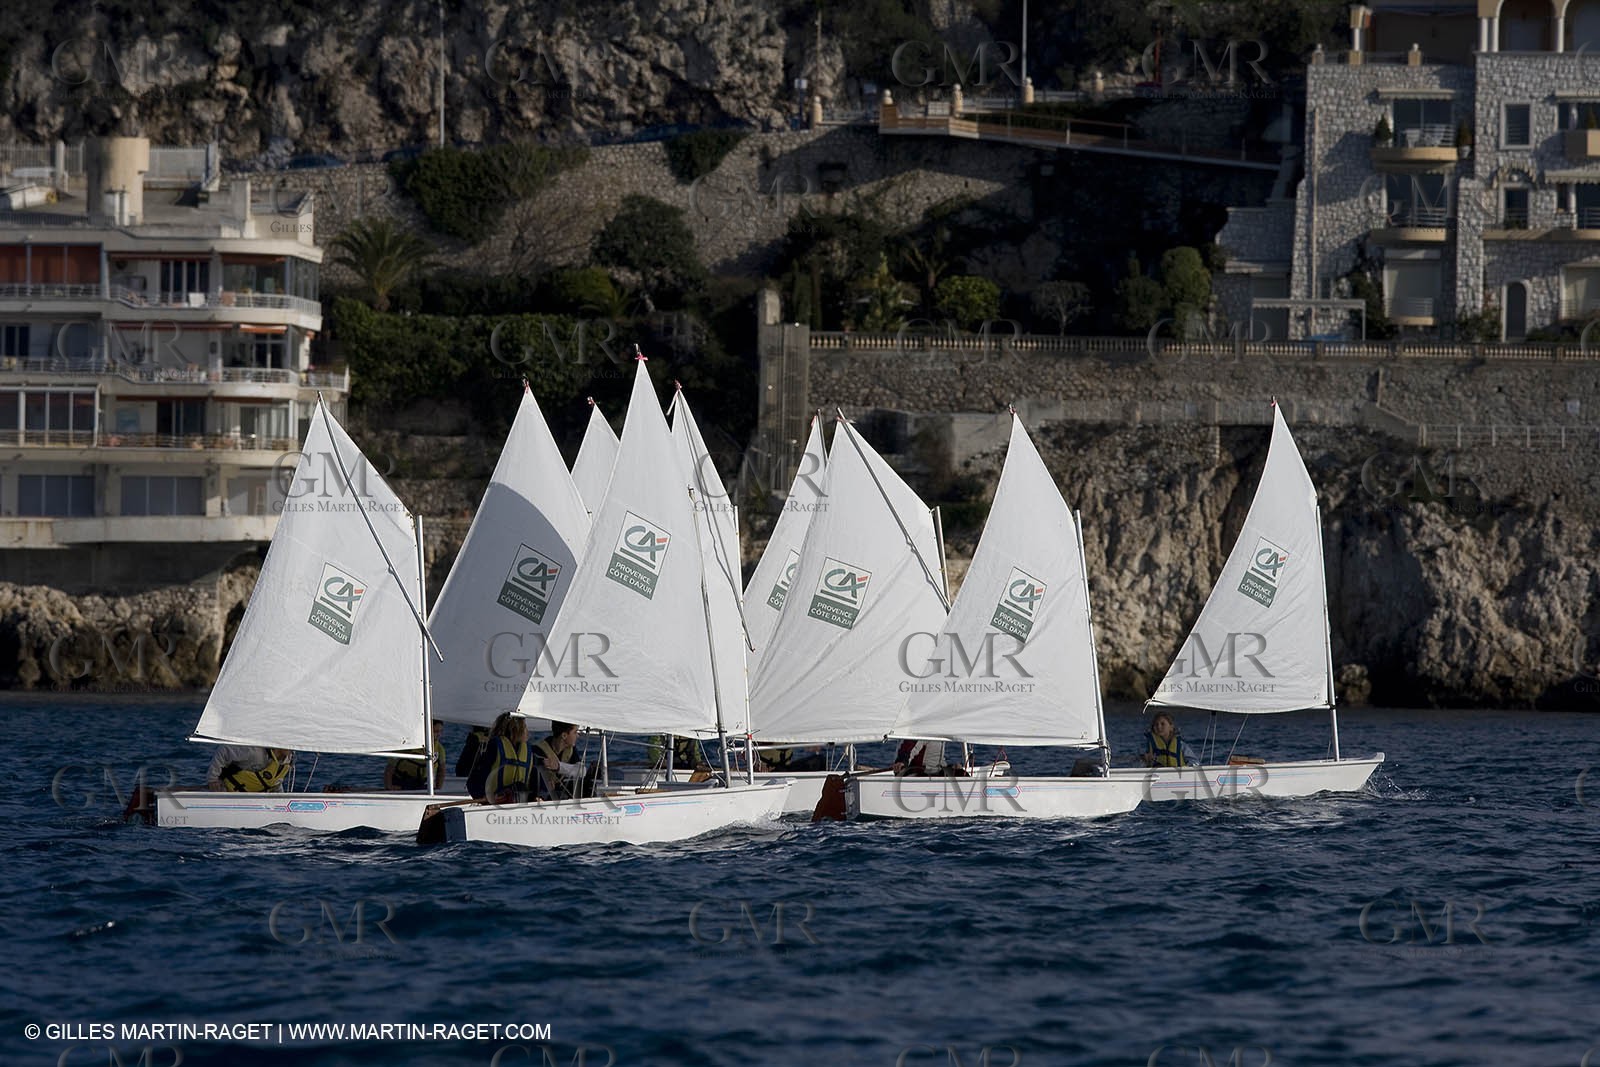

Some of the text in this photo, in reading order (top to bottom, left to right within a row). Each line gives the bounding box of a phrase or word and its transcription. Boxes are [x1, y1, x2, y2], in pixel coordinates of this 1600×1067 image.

[616, 561, 651, 585] PROVENCE
[507, 589, 540, 611] PROVENCE
[816, 602, 853, 619] PROVENCE
[317, 609, 346, 632] PROVENCE
[999, 611, 1027, 632] PROVENCE
